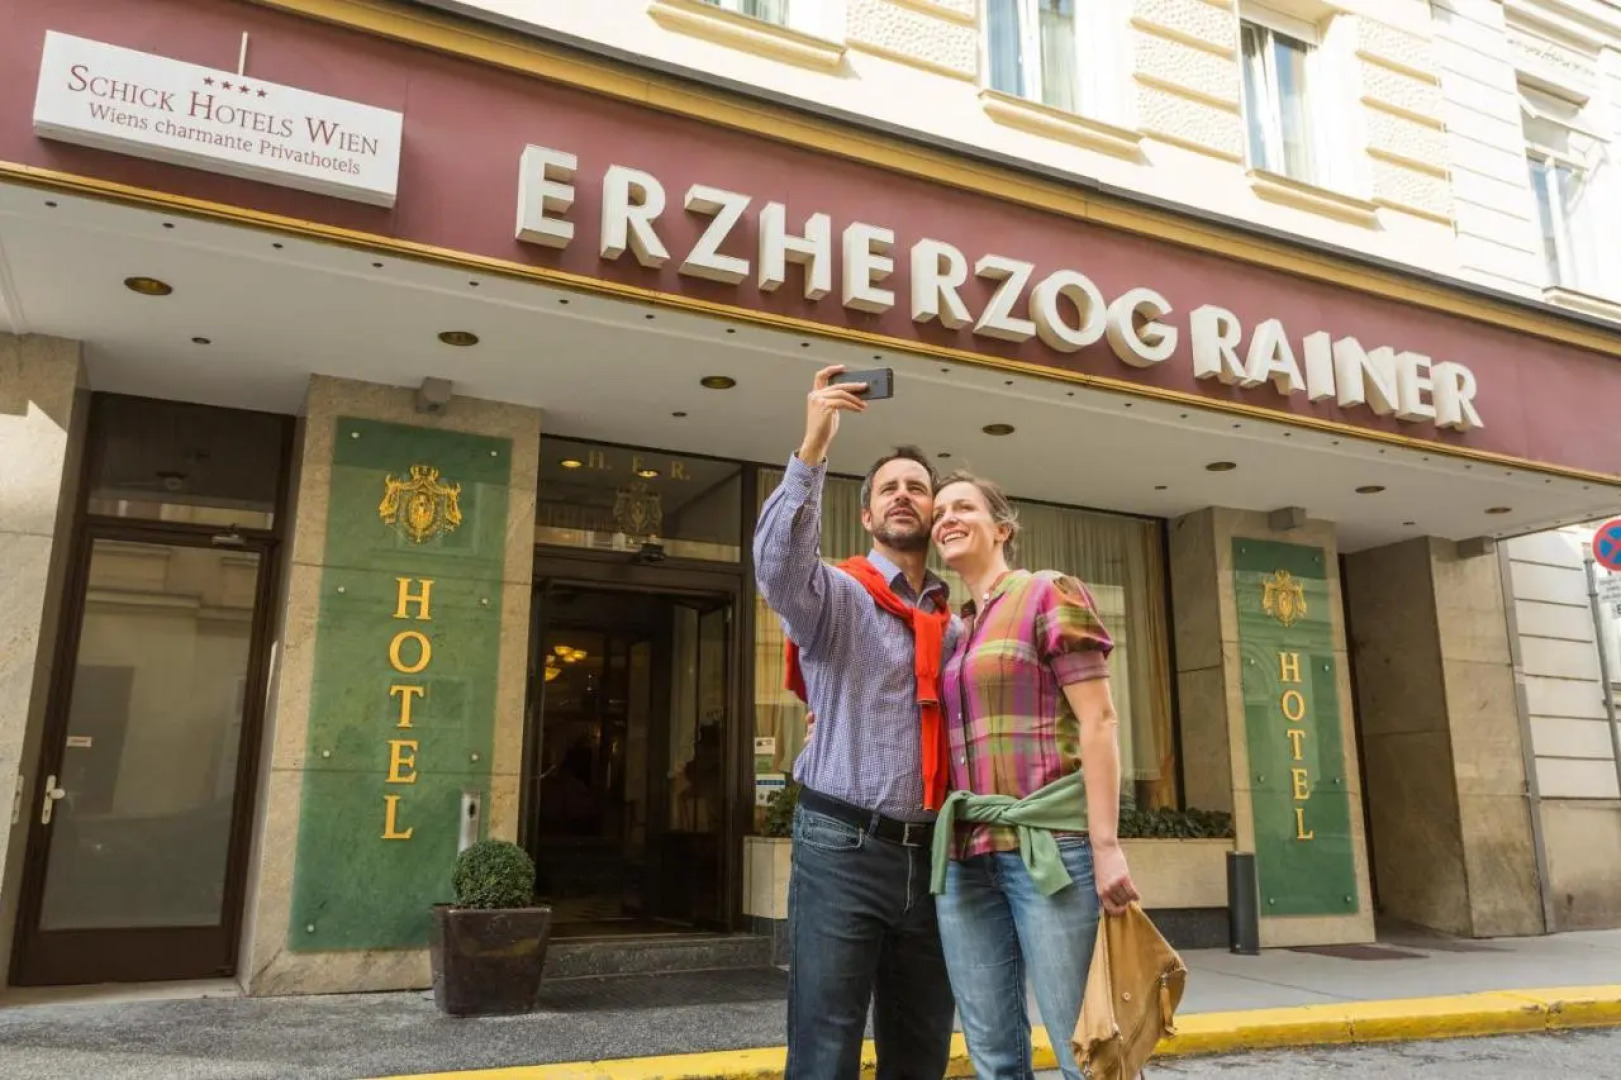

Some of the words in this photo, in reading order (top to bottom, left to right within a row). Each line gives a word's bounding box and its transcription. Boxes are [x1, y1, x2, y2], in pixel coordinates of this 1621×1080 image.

[67, 64, 176, 113] SCHICK
[188, 90, 294, 138] HOTELS
[305, 116, 379, 156] WIEN
[89, 101, 148, 130] Wiens
[155, 118, 253, 153] charmante
[258, 139, 361, 175] Privathotels
[515, 143, 1179, 368] ERZHERZOG
[1189, 303, 1485, 432] RAINER
[380, 577, 435, 840] HOTEL
[1278, 652, 1314, 840] HOTEL
